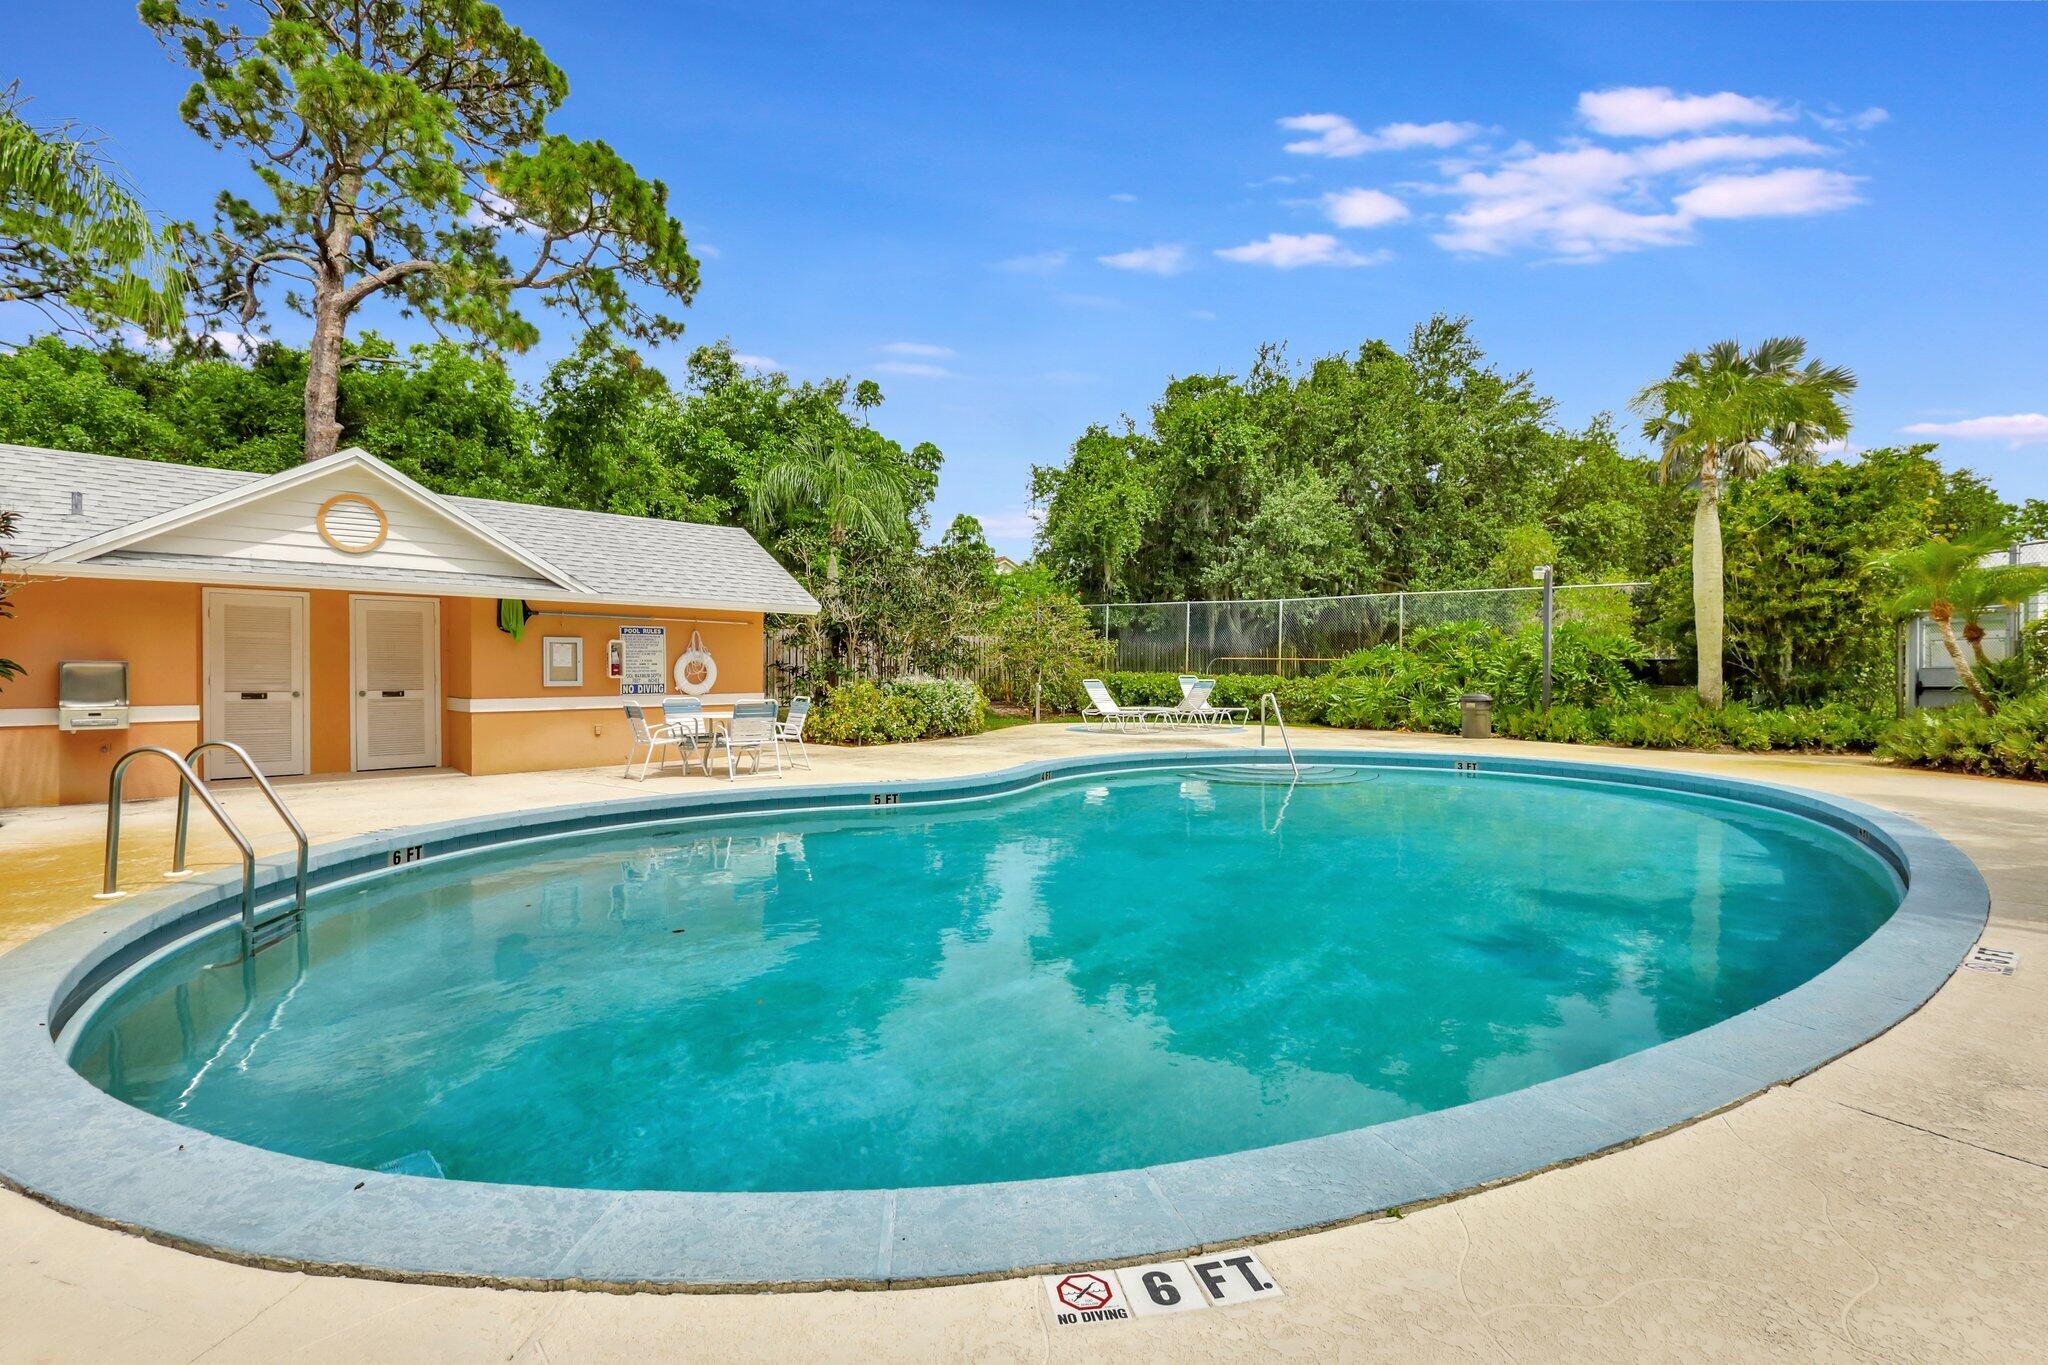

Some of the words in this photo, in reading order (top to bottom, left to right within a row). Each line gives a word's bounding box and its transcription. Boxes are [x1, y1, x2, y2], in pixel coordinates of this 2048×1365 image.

[622, 685, 634, 693] NO
[637, 685, 664, 693] DIVING
[874, 794, 881, 804] 5
[886, 794, 898, 804] FT
[393, 850, 401, 865] 6
[407, 845, 422, 862] FT
[1142, 1271, 1182, 1306] 6
[1194, 1255, 1274, 1299] FT.
[1057, 1313, 1077, 1325] NO
[1081, 1308, 1128, 1322] DIVING
